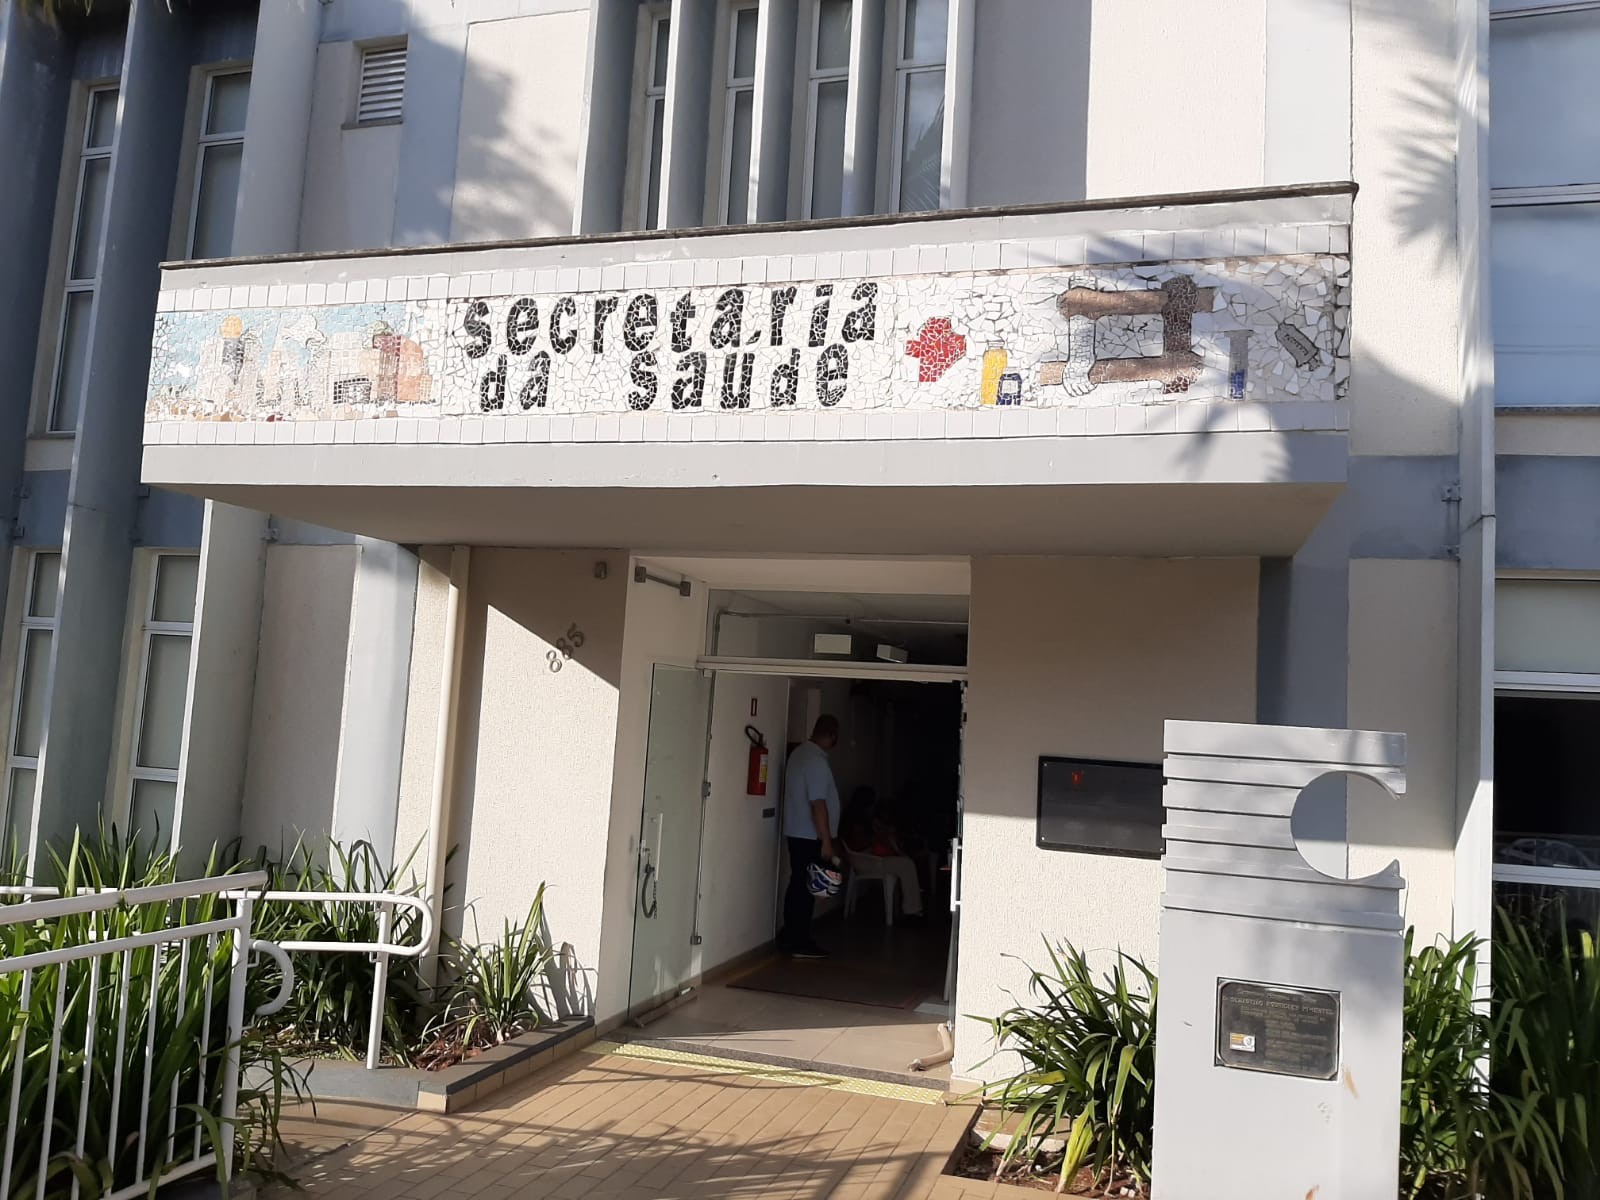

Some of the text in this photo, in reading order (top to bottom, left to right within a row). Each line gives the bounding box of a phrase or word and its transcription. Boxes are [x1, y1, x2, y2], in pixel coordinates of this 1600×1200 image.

[463, 282, 878, 359] secretaria
[480, 351, 552, 412] da
[545, 622, 585, 673] 885
